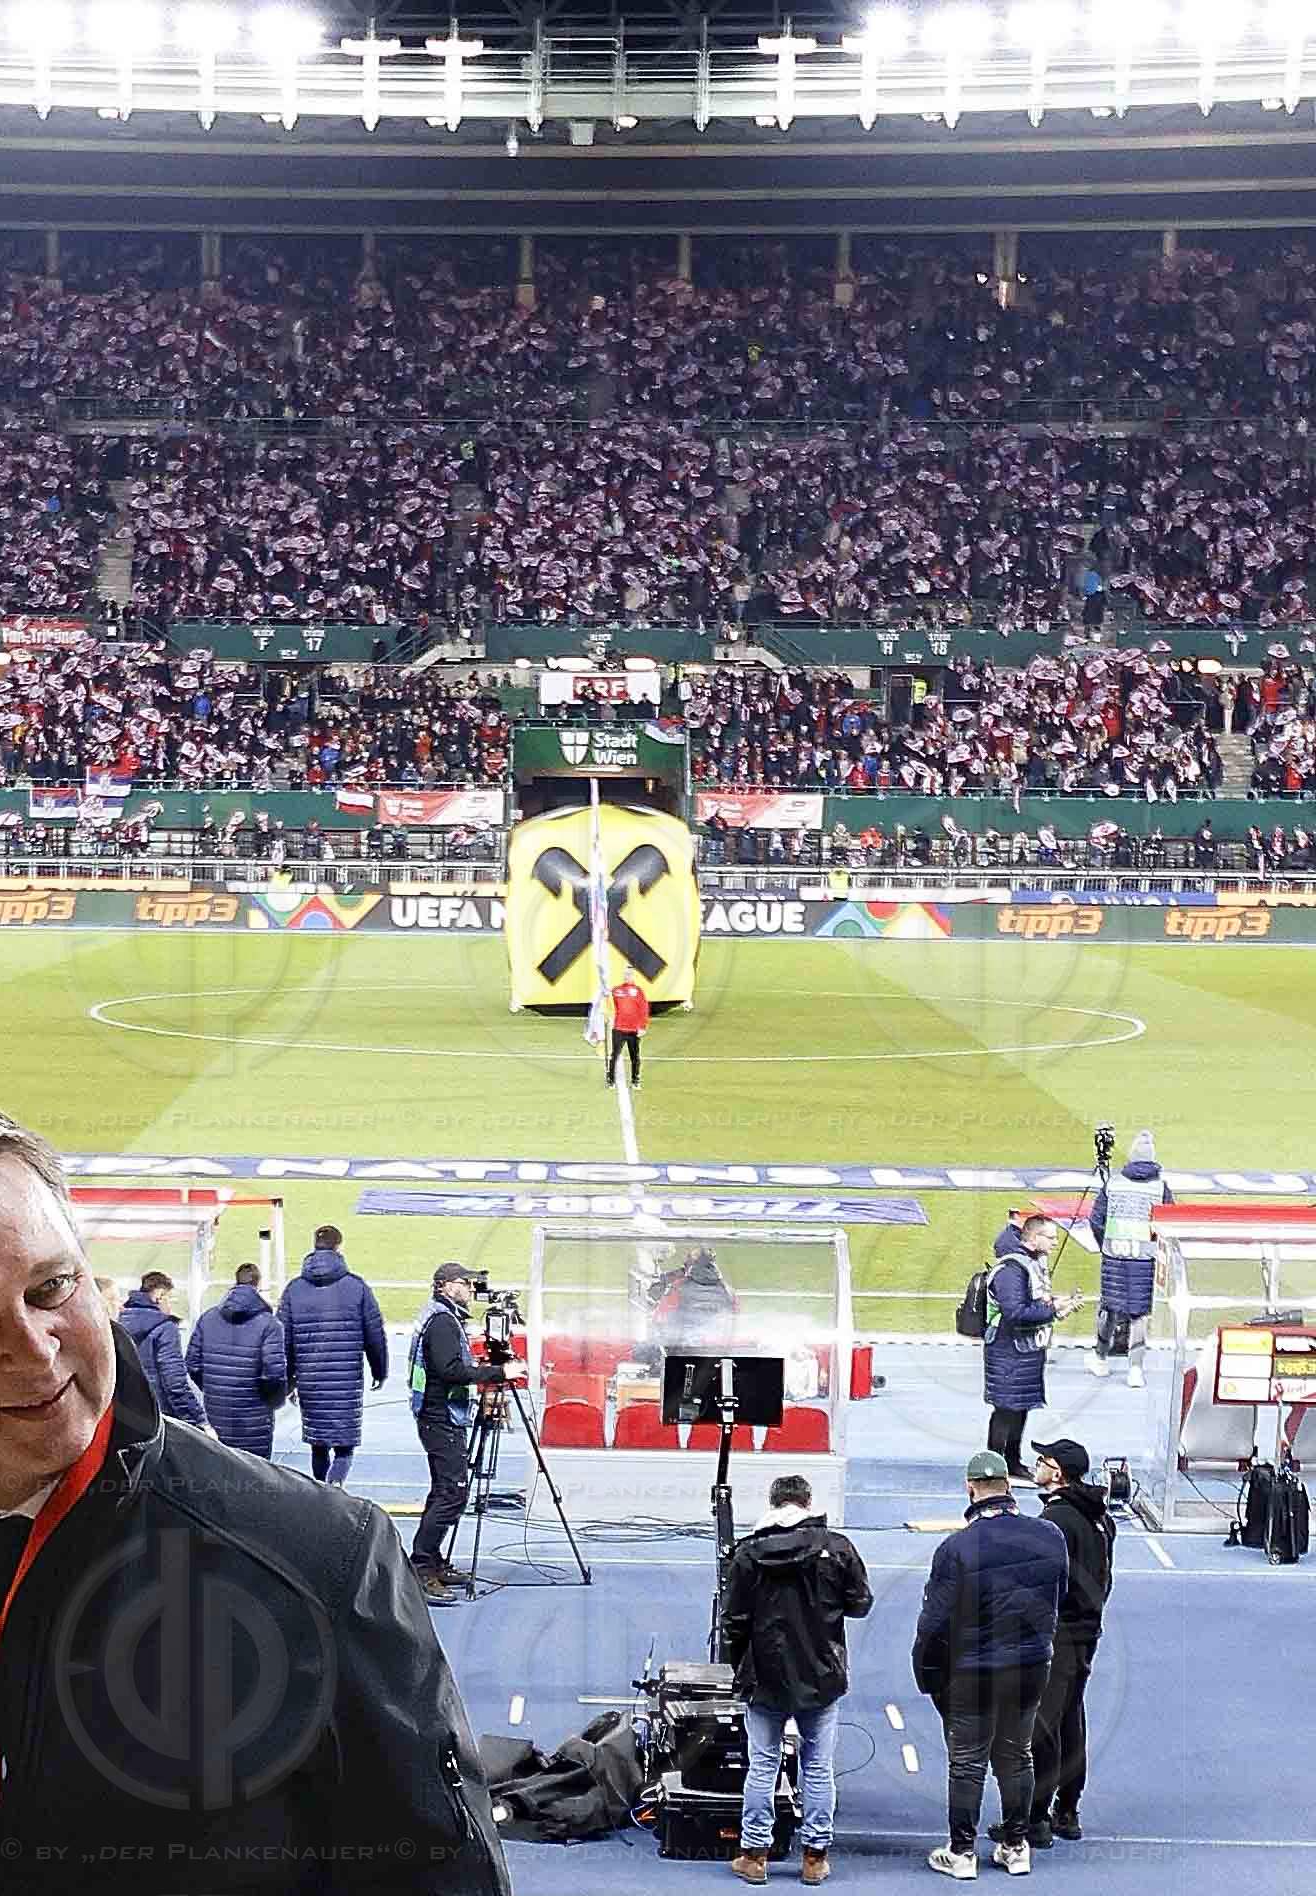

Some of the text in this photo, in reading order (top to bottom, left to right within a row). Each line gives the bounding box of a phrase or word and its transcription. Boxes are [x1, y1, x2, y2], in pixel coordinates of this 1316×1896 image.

[591, 749, 637, 765] Wien
[593, 732, 638, 748] Stadt
[135, 892, 238, 927] tipp3
[390, 897, 483, 929] UEFA
[700, 901, 806, 933] AGUE
[997, 903, 1103, 938] tipp3
[1163, 905, 1271, 941] tipp3
